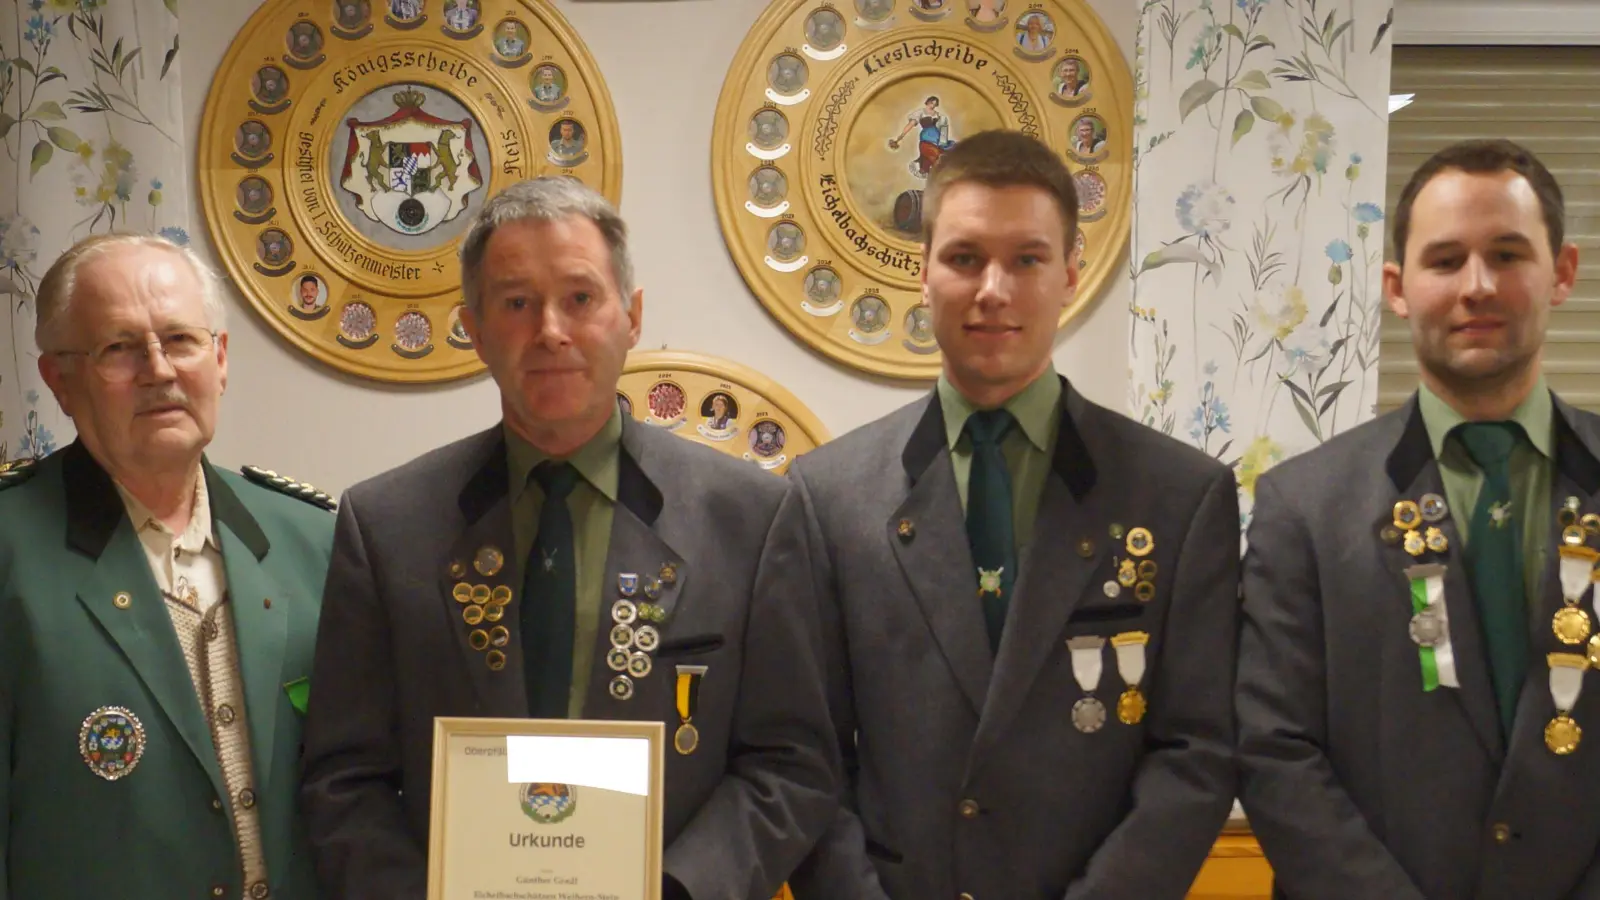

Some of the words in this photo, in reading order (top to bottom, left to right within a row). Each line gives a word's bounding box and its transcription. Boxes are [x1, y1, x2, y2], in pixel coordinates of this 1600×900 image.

[332, 51, 478, 94] Königsscheibe
[863, 39, 988, 75] Lieslscheibe
[303, 187, 320, 213] von
[509, 832, 585, 849] Urkunde
